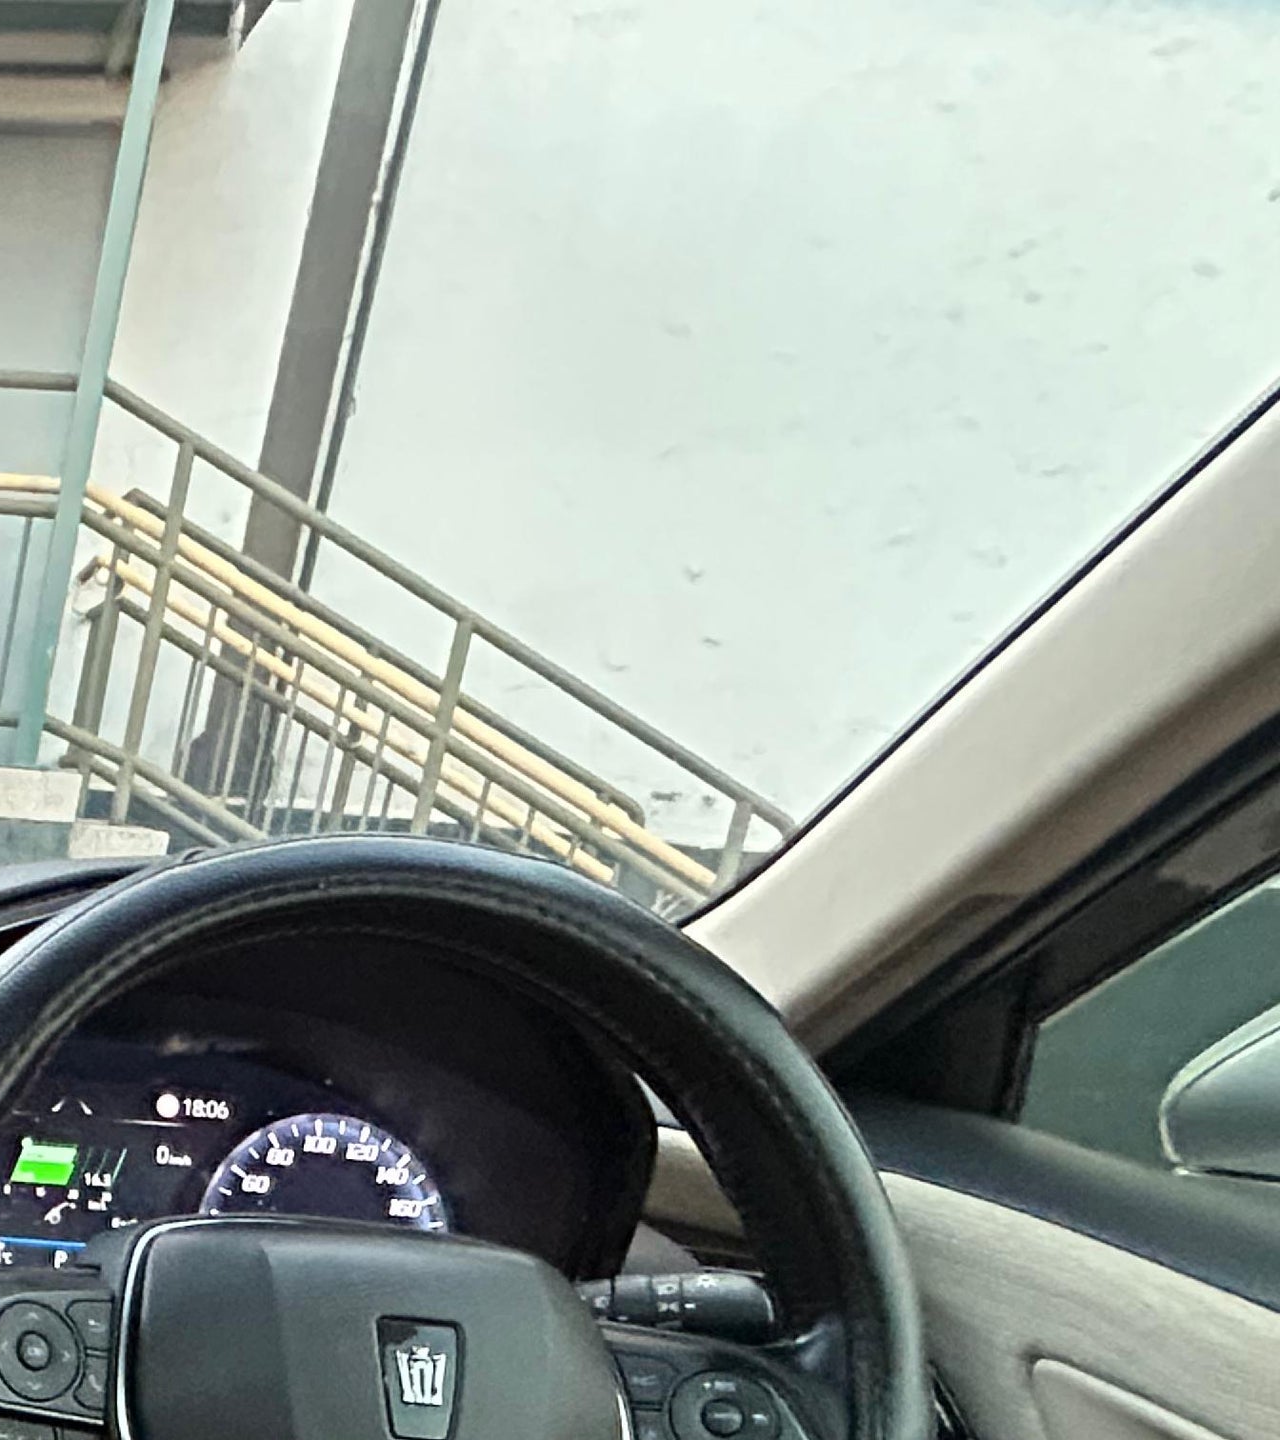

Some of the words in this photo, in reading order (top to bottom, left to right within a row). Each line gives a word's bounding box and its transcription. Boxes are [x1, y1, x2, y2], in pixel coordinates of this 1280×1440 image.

[183, 1097, 230, 1120] 18:06
[303, 1135, 337, 1154] 100
[345, 1143, 379, 1162] 120
[266, 1147, 295, 1166] 80
[241, 1174, 270, 1194] 60
[376, 1166, 410, 1185] 140
[389, 1199, 423, 1219] 160
[53, 1250, 69, 1269] P
